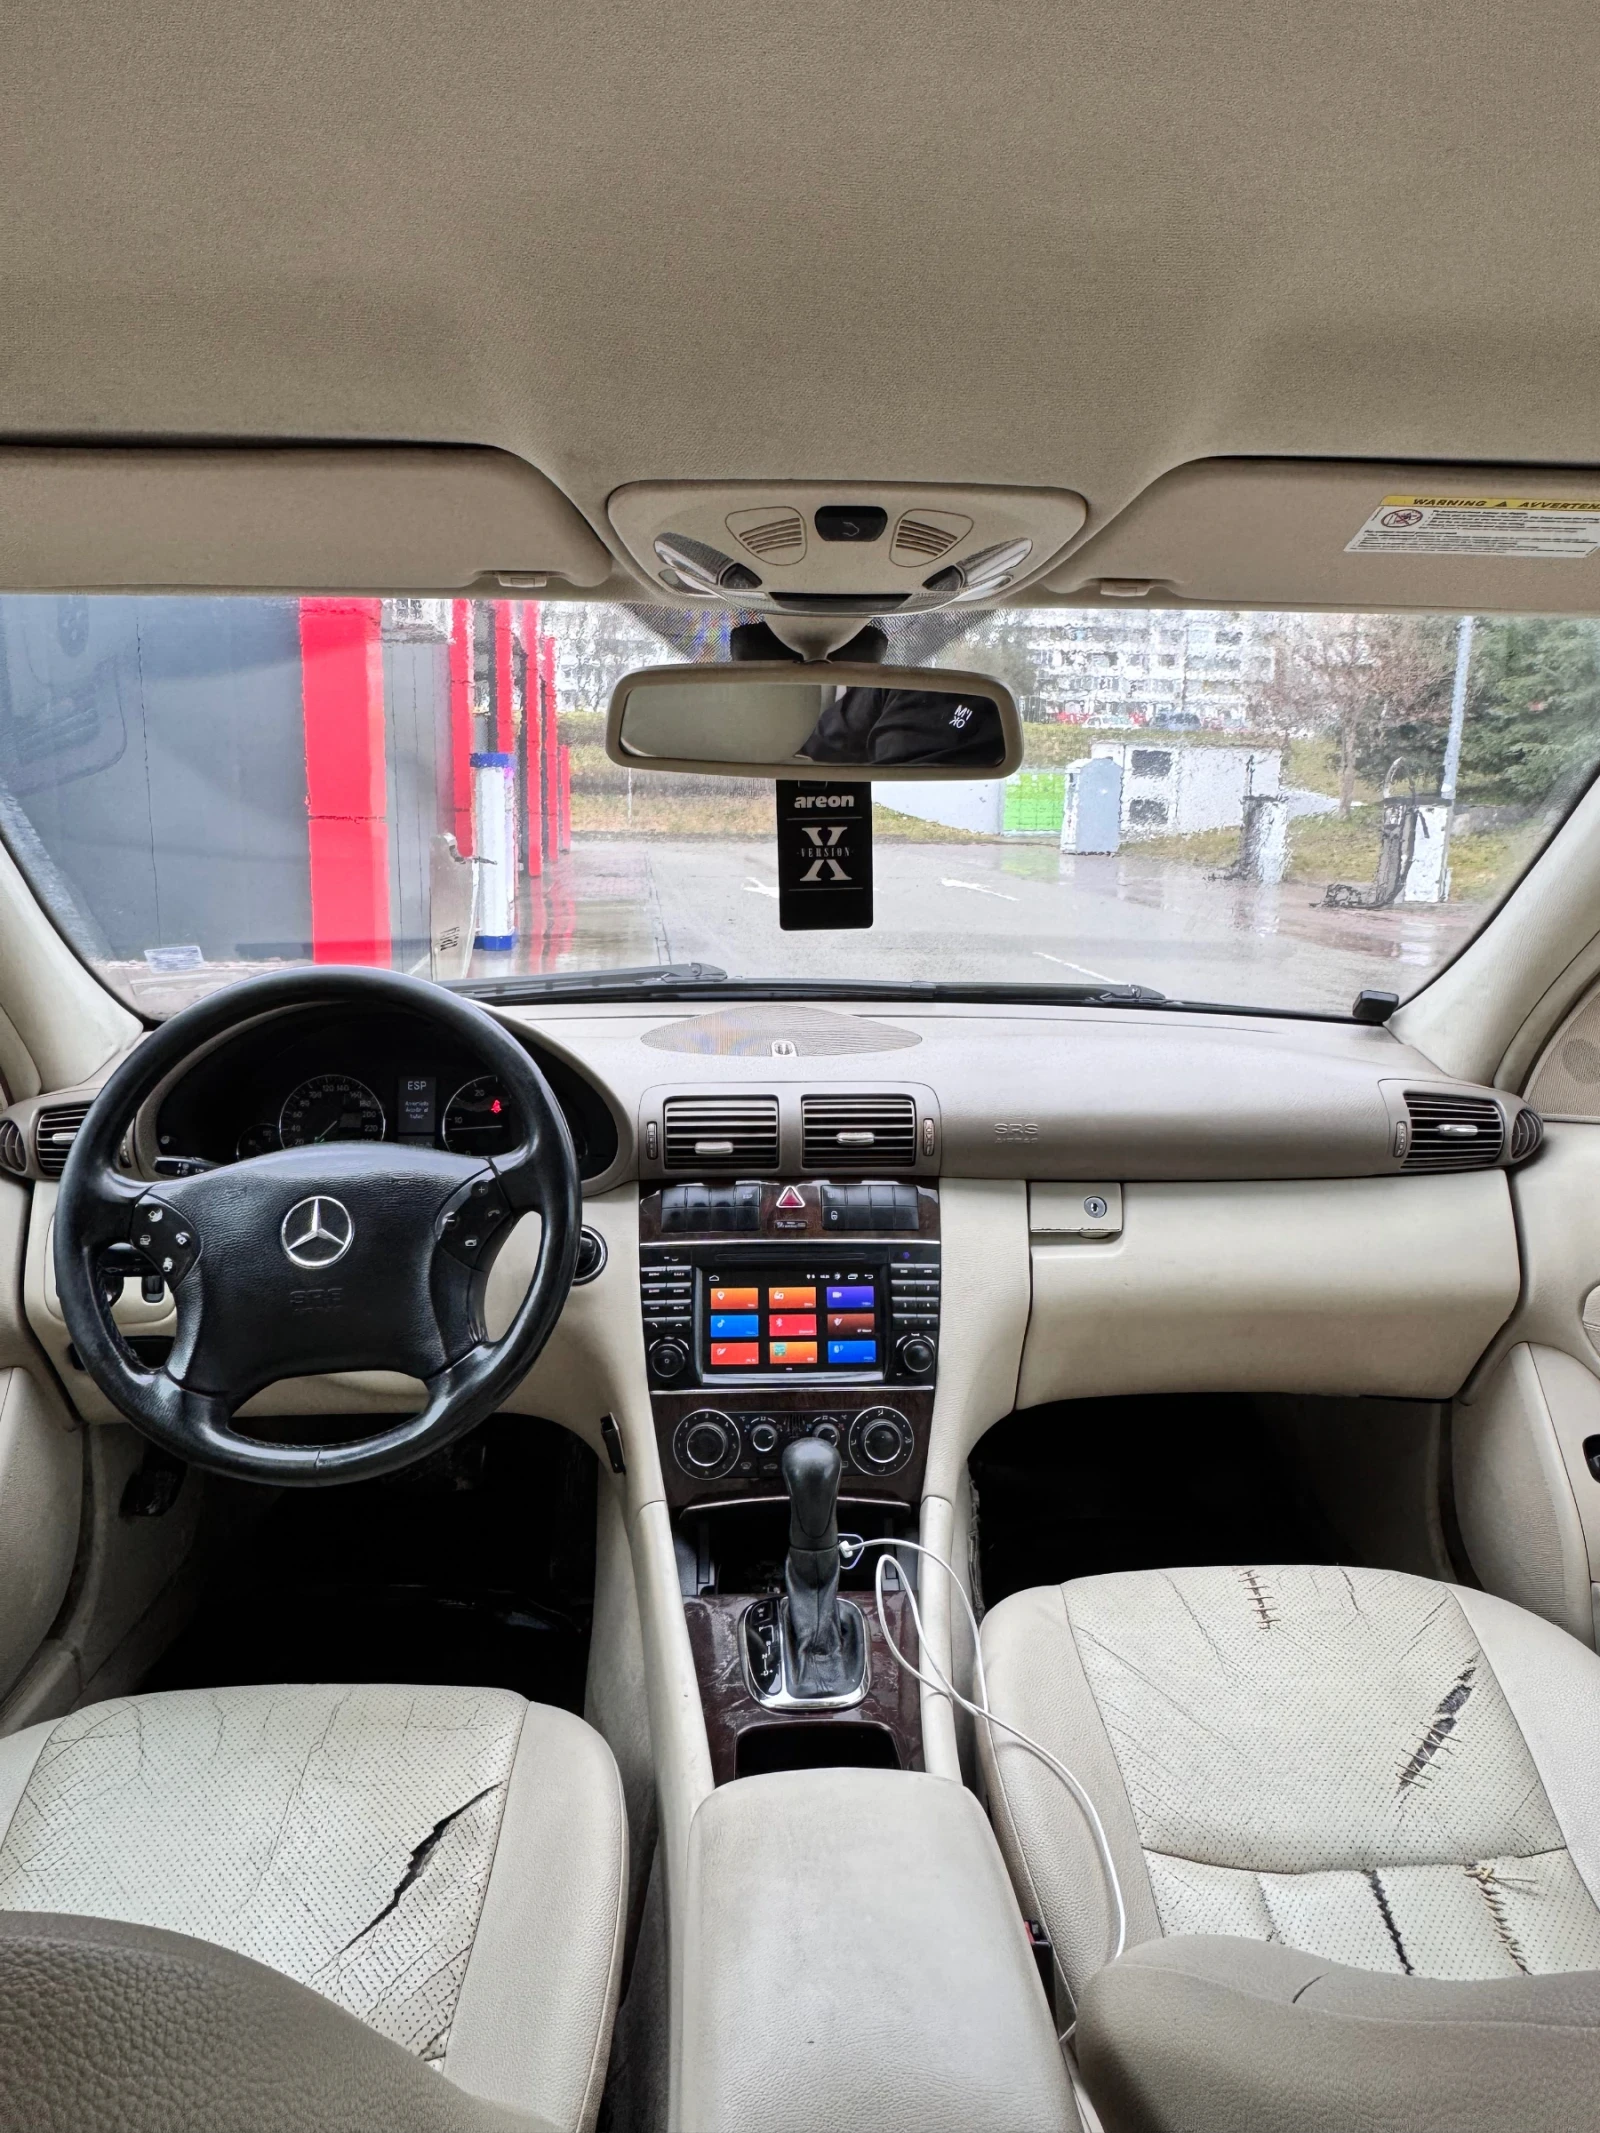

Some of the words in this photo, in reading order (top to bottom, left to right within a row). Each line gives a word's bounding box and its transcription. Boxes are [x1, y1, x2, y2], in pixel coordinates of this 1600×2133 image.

[1412, 498, 1488, 507] WARNING
[1517, 501, 1600, 510] AVVERTEN
[794, 795, 855, 809] areon
[799, 846, 852, 858] VERSION
[407, 1080, 427, 1091] ESP
[364, 1124, 378, 1132] 220
[994, 1122, 1039, 1135] SRS
